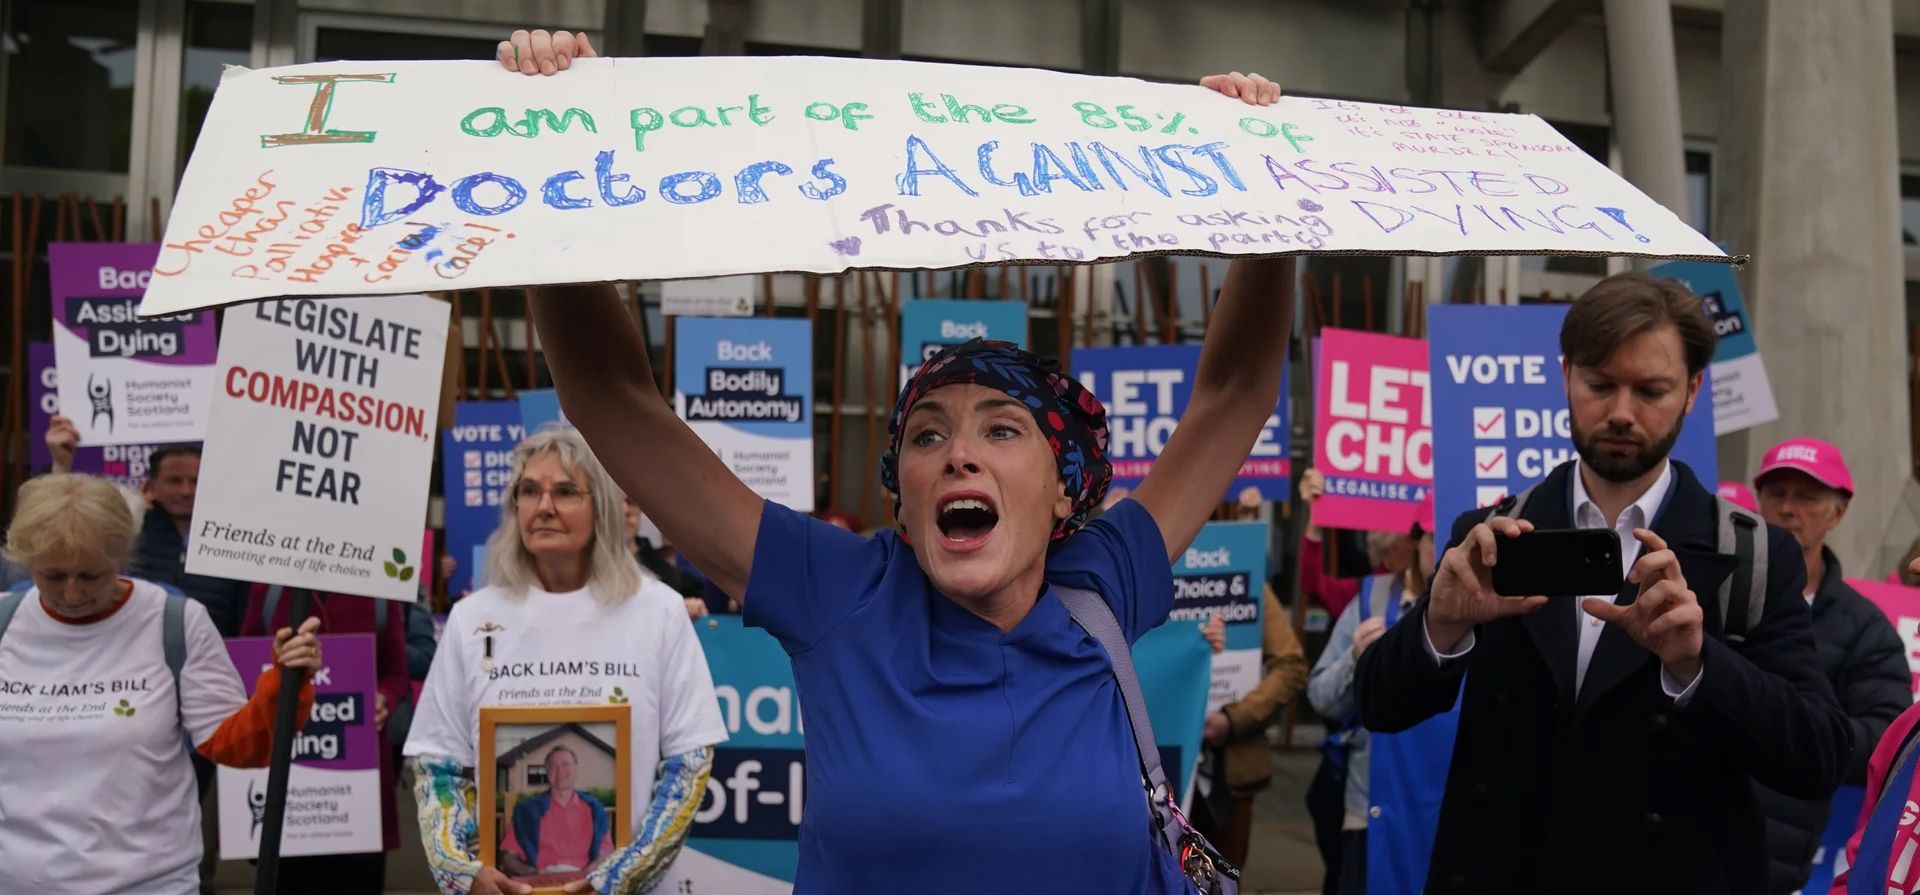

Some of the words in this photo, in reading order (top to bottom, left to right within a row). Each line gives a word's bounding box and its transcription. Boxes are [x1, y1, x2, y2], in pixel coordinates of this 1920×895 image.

[261, 72, 397, 149] I
[460, 106, 598, 138] am
[630, 94, 776, 152] part
[805, 101, 875, 132] of
[907, 92, 1037, 125] the
[897, 134, 1248, 198] AGAINST
[1260, 153, 1569, 197] ASSISTED
[215, 201, 296, 257] than
[860, 203, 1065, 237] Thanks
[1082, 210, 1152, 241] for
[1176, 207, 1334, 238] asking
[1350, 200, 1651, 244] DYING!
[1037, 240, 1086, 262] to
[1112, 229, 1180, 251] the
[1208, 228, 1326, 250] party
[99, 267, 152, 289] Bac
[98, 329, 177, 355] Dying
[256, 299, 422, 360] LEGISLATE
[941, 320, 989, 338] Back
[296, 338, 379, 388] WITH
[718, 341, 773, 361] Back
[710, 370, 780, 396] Bodily
[1446, 355, 1547, 384] VOTE
[126, 391, 178, 404] Society
[225, 366, 429, 442] COMPASSION,
[1329, 360, 1432, 426] LET
[127, 403, 189, 417] Scotland
[689, 397, 801, 422] Autonomy
[292, 420, 359, 462] NOT
[452, 424, 502, 442] VOTE
[1325, 421, 1433, 480] CHO
[276, 459, 361, 505] FEAR
[1326, 479, 1408, 500] LEGALISE
[200, 520, 277, 548] Friends
[281, 536, 301, 550] at
[306, 537, 335, 556] the
[339, 541, 375, 561] End
[198, 544, 266, 566] Promoting
[268, 555, 290, 568] end
[293, 558, 309, 572] of
[308, 560, 327, 573] life
[328, 563, 371, 578] choices
[1185, 547, 1231, 568] Back
[1230, 575, 1245, 596] &
[489, 662, 535, 681] BACK
[540, 661, 599, 677] LIAM'S
[605, 662, 640, 678] BILL
[0, 681, 36, 696] ACK
[40, 682, 105, 697] LIAM'S
[111, 678, 152, 693] BILL
[498, 687, 540, 700] Friends
[543, 687, 556, 699] at
[559, 686, 577, 698] the
[579, 687, 602, 698] End
